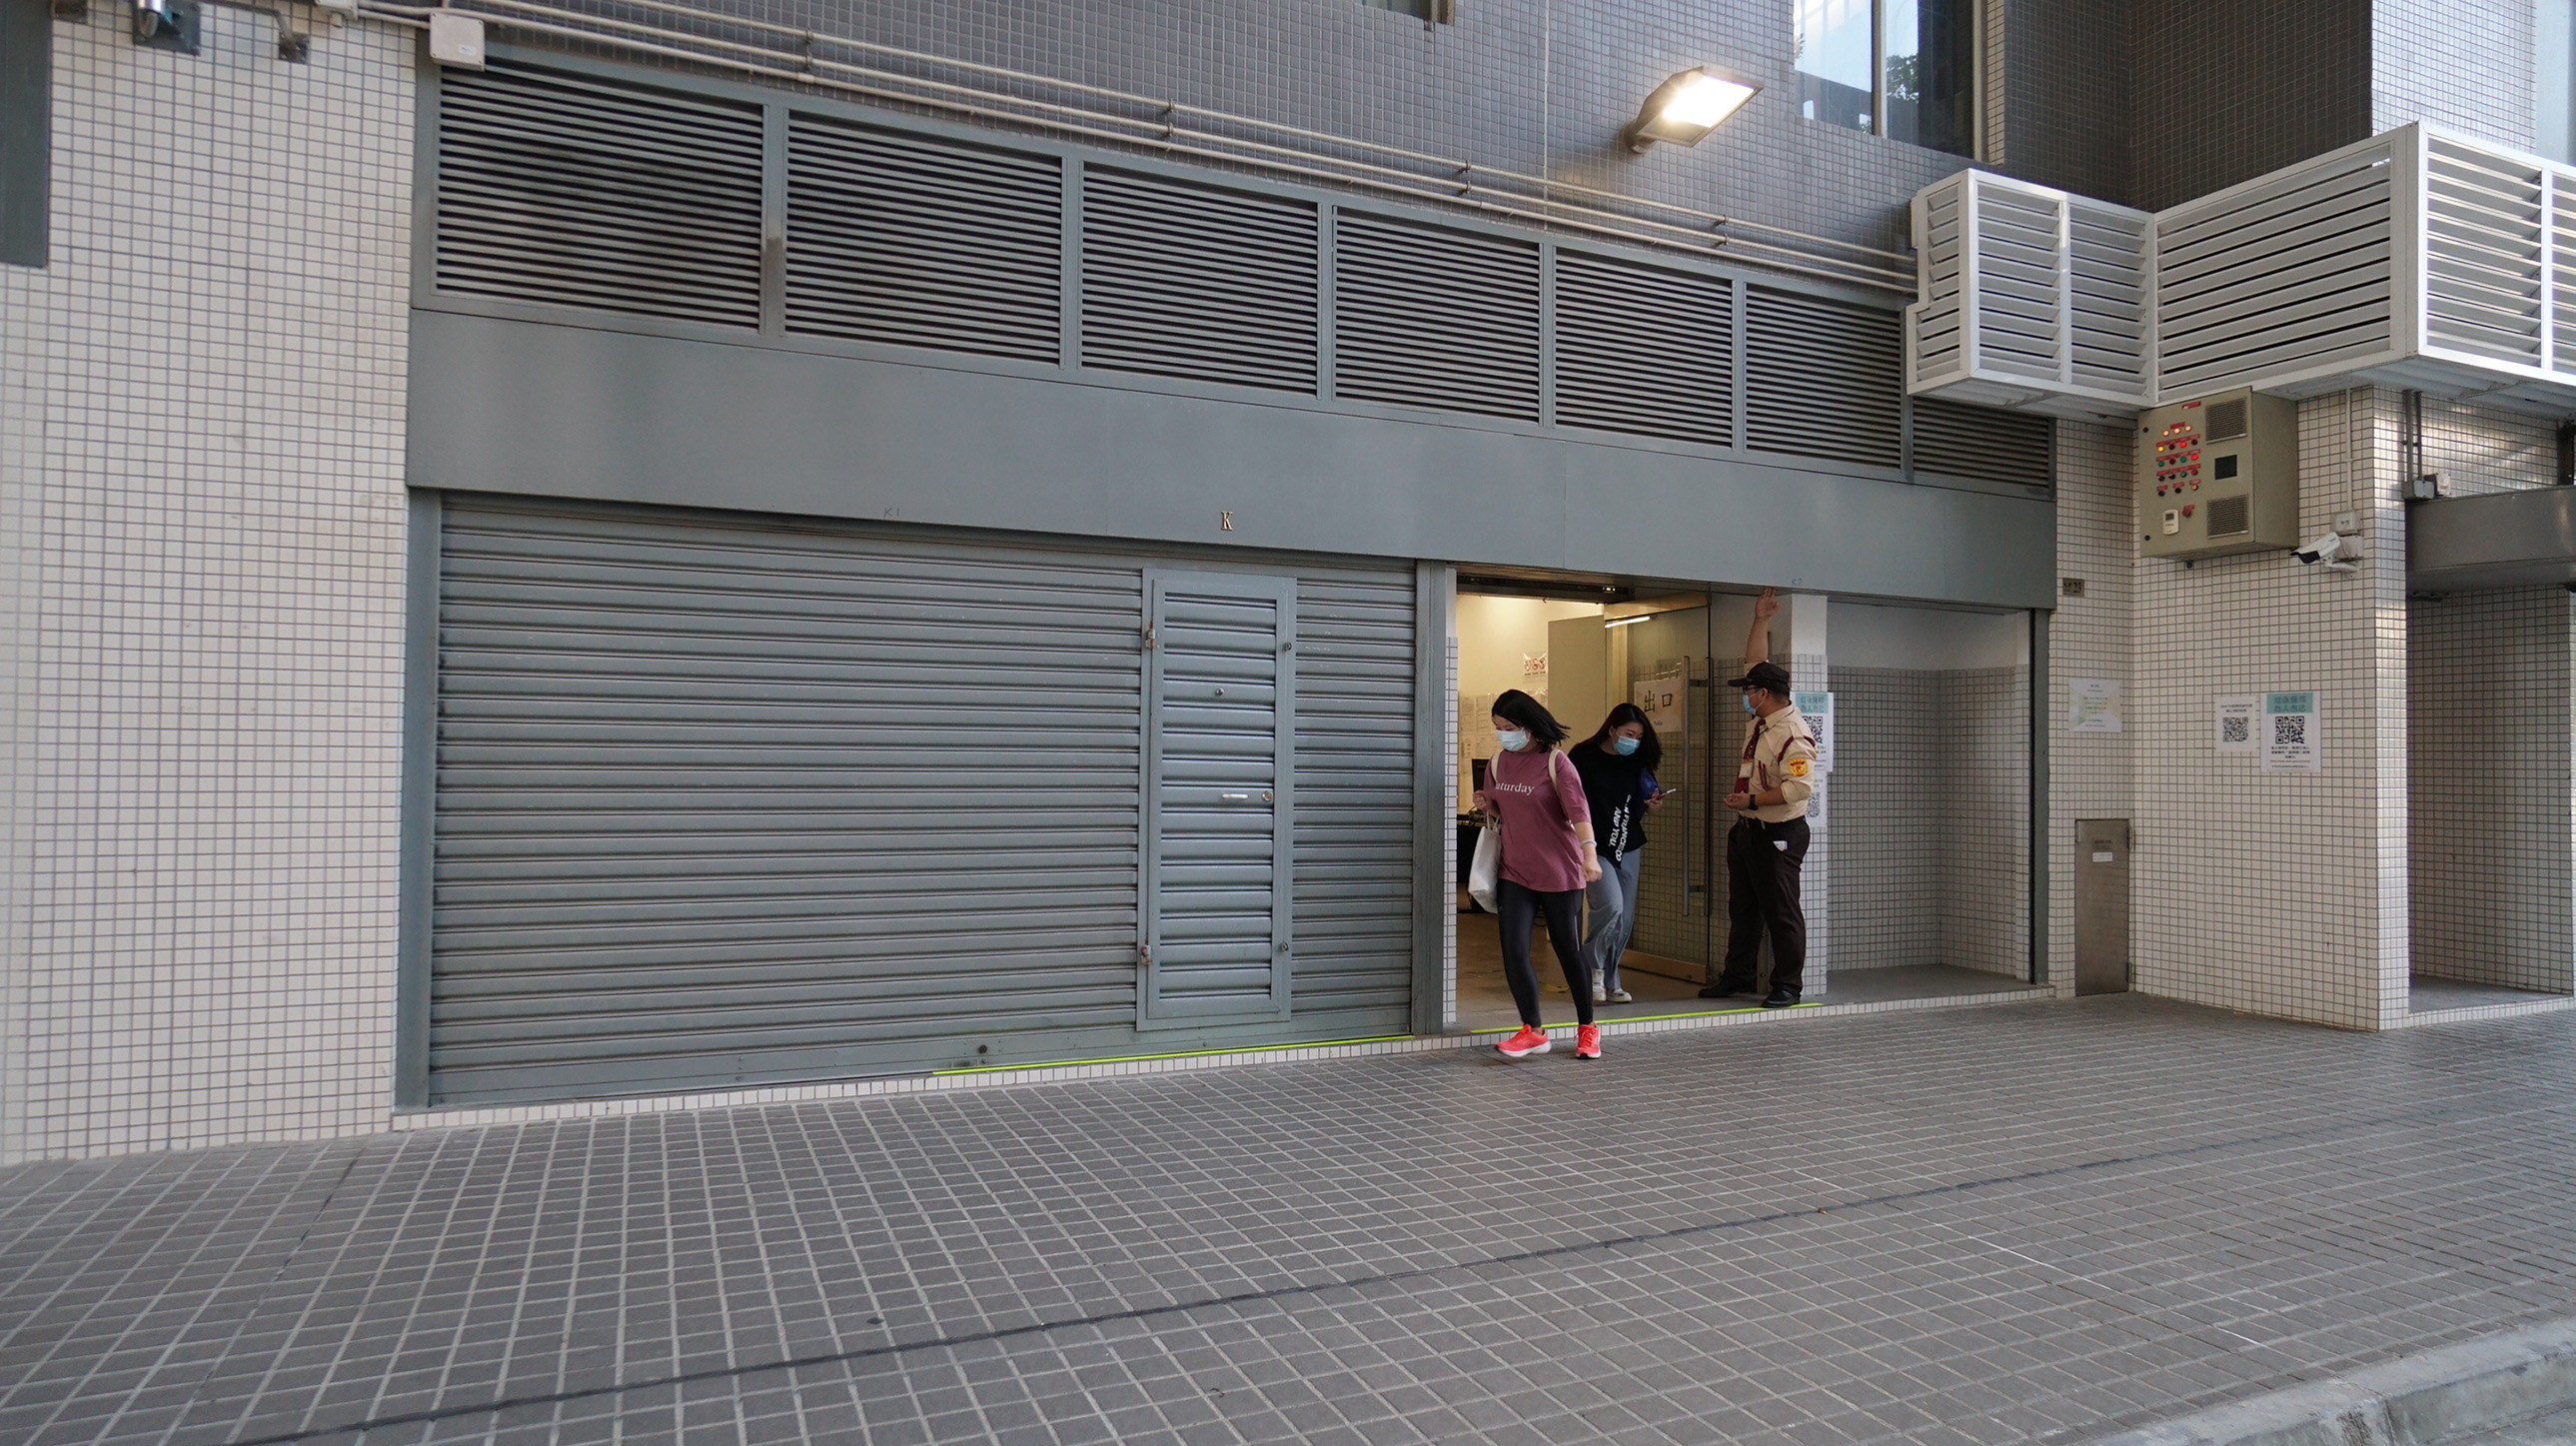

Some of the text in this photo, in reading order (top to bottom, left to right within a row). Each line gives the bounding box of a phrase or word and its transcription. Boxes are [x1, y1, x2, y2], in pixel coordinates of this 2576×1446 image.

[1220, 511, 1234, 531] K
[1644, 690, 1673, 713] 出口
[1495, 780, 1535, 796] aturday
